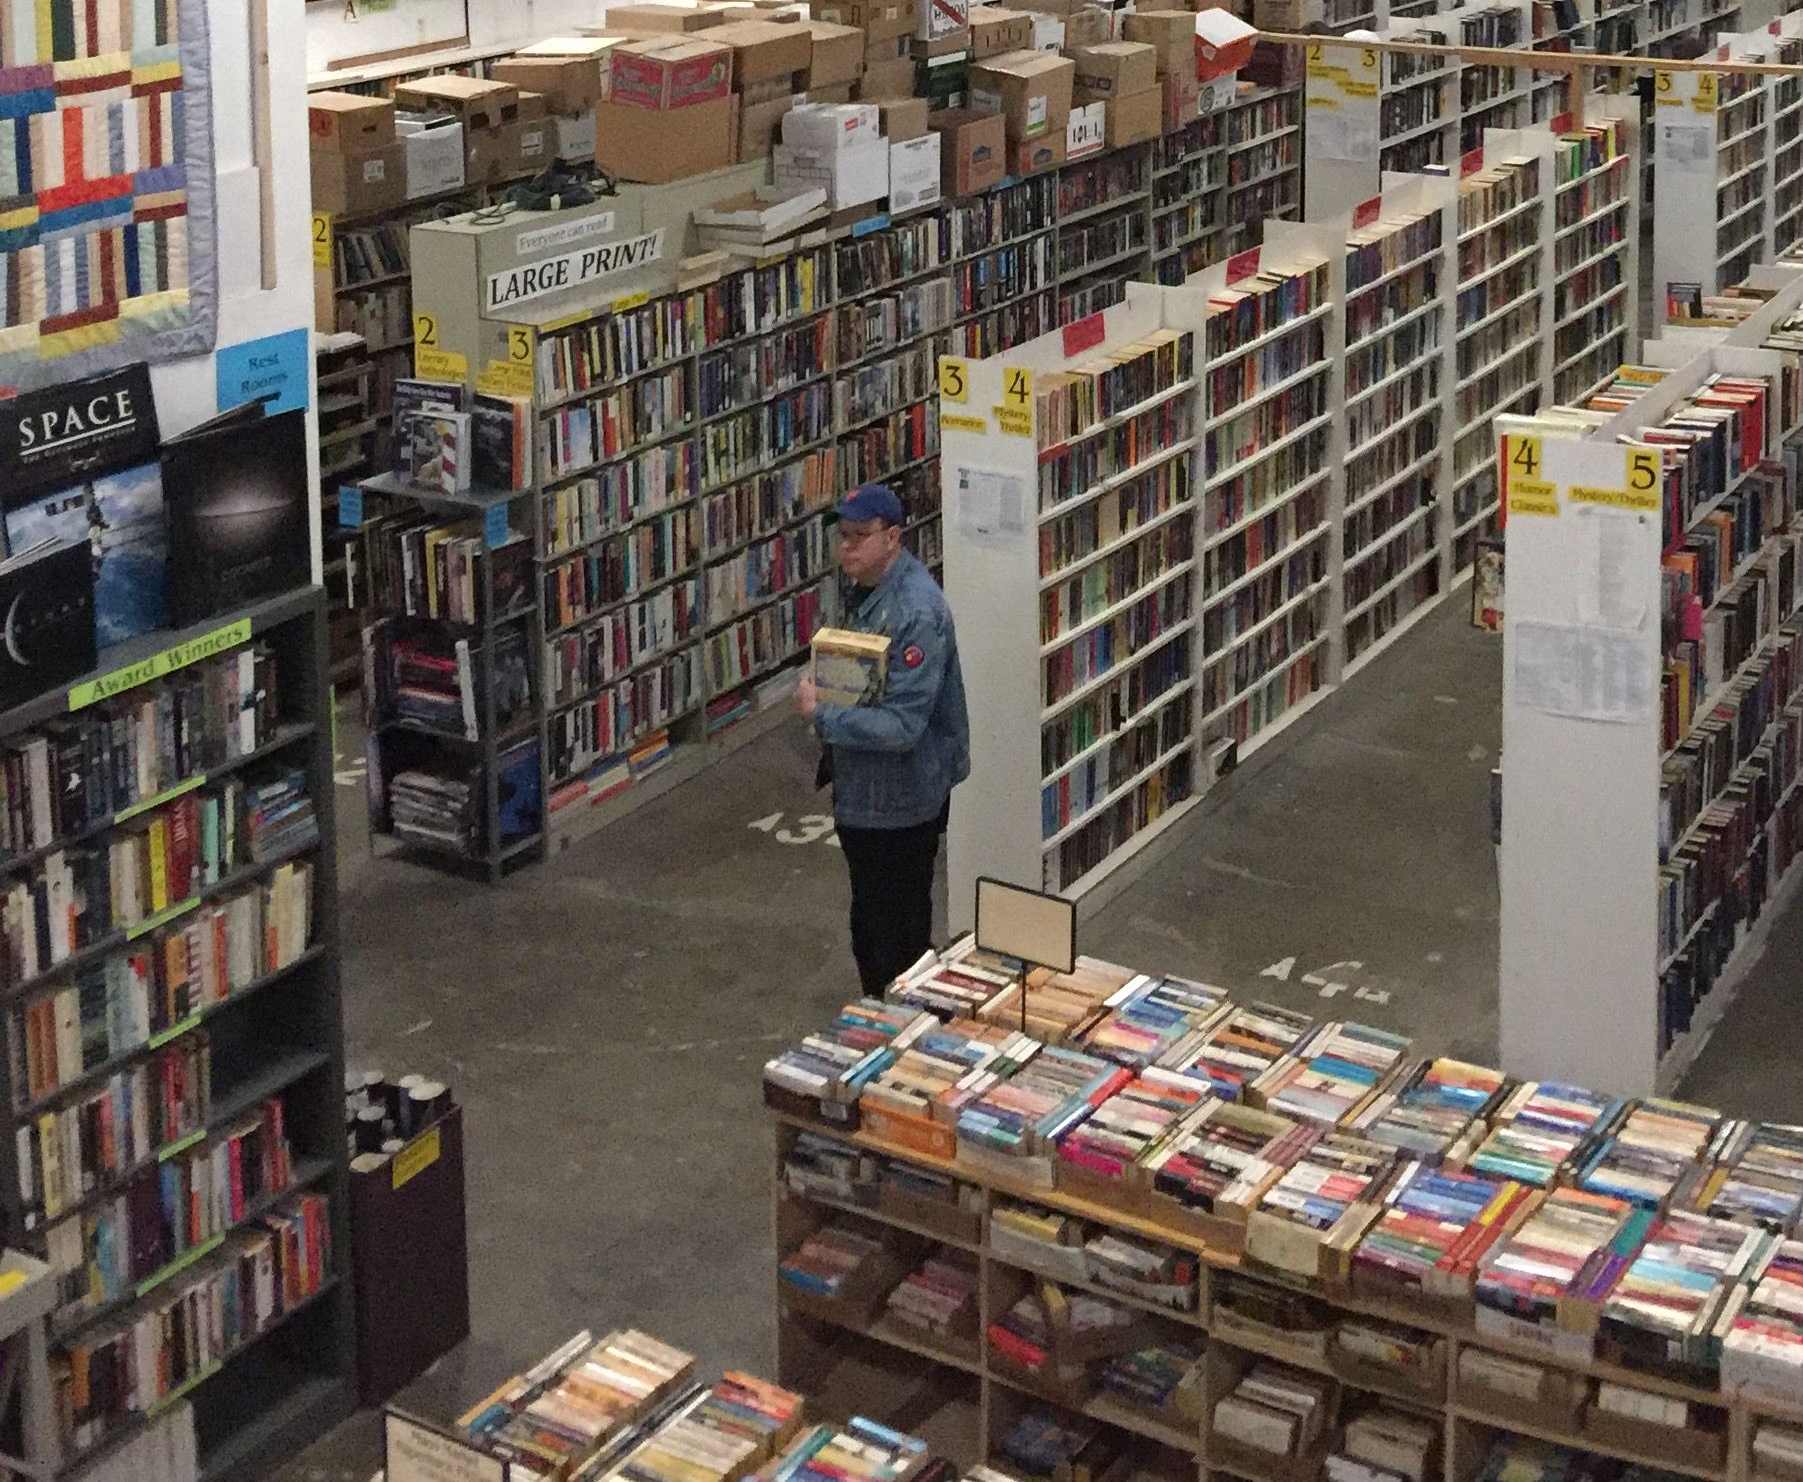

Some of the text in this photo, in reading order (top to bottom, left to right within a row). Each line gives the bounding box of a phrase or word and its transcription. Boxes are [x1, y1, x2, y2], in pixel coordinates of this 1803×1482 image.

[344, 1, 358, 21] A
[1362, 48, 1376, 68] 3
[1657, 74, 1713, 94] 3 4
[312, 217, 327, 243] 2
[518, 216, 609, 251] Everyone can read
[492, 237, 658, 305] LARGE PRINT!
[418, 315, 435, 346] 2
[513, 330, 530, 360] 3
[248, 353, 280, 372] Rest
[240, 374, 288, 395] Rooms
[943, 365, 1030, 404] 3 4
[18, 388, 135, 448] SPACE
[1512, 438, 1656, 489] 4 5
[1512, 482, 1553, 494] Humor
[91, 626, 244, 701] Award Winners
